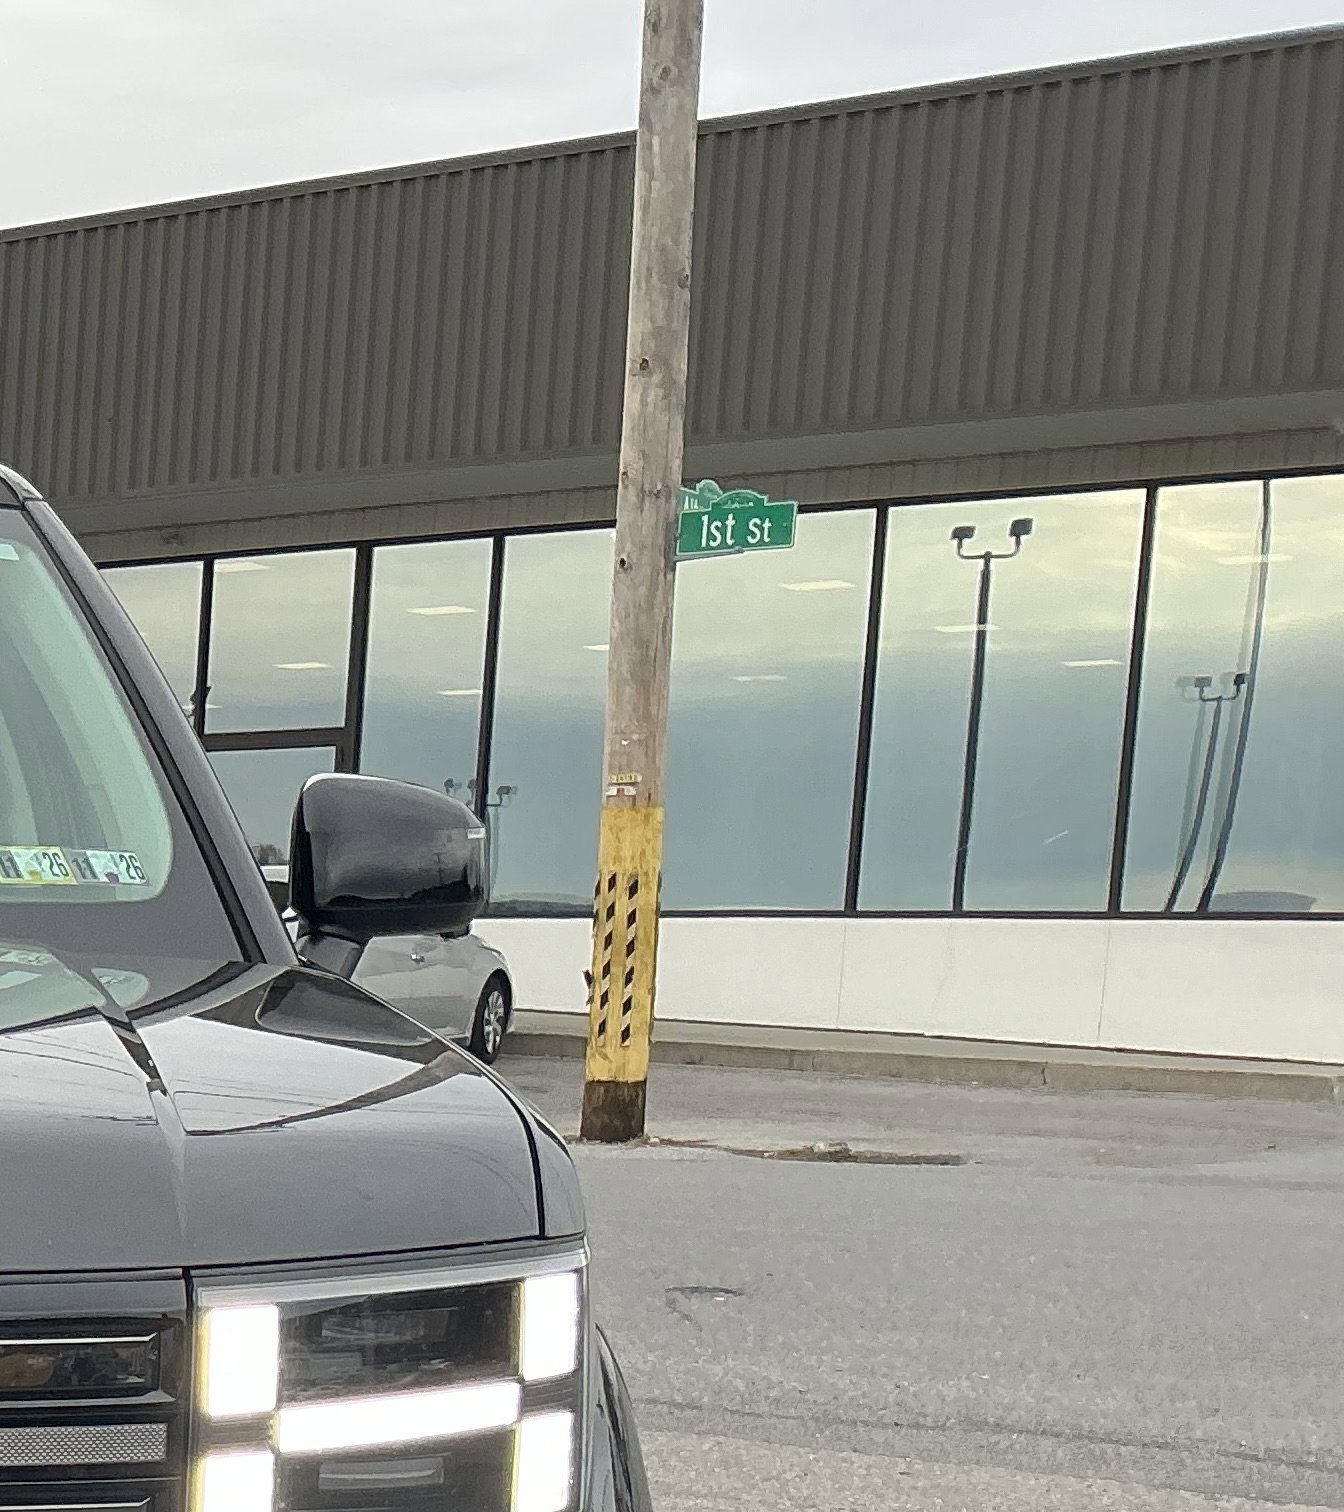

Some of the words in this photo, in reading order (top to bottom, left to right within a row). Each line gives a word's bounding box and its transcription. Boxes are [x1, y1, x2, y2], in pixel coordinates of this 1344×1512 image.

[701, 513, 736, 547] 1st
[746, 517, 773, 544] St
[41, 852, 69, 877] 26
[119, 854, 146, 880] 26
